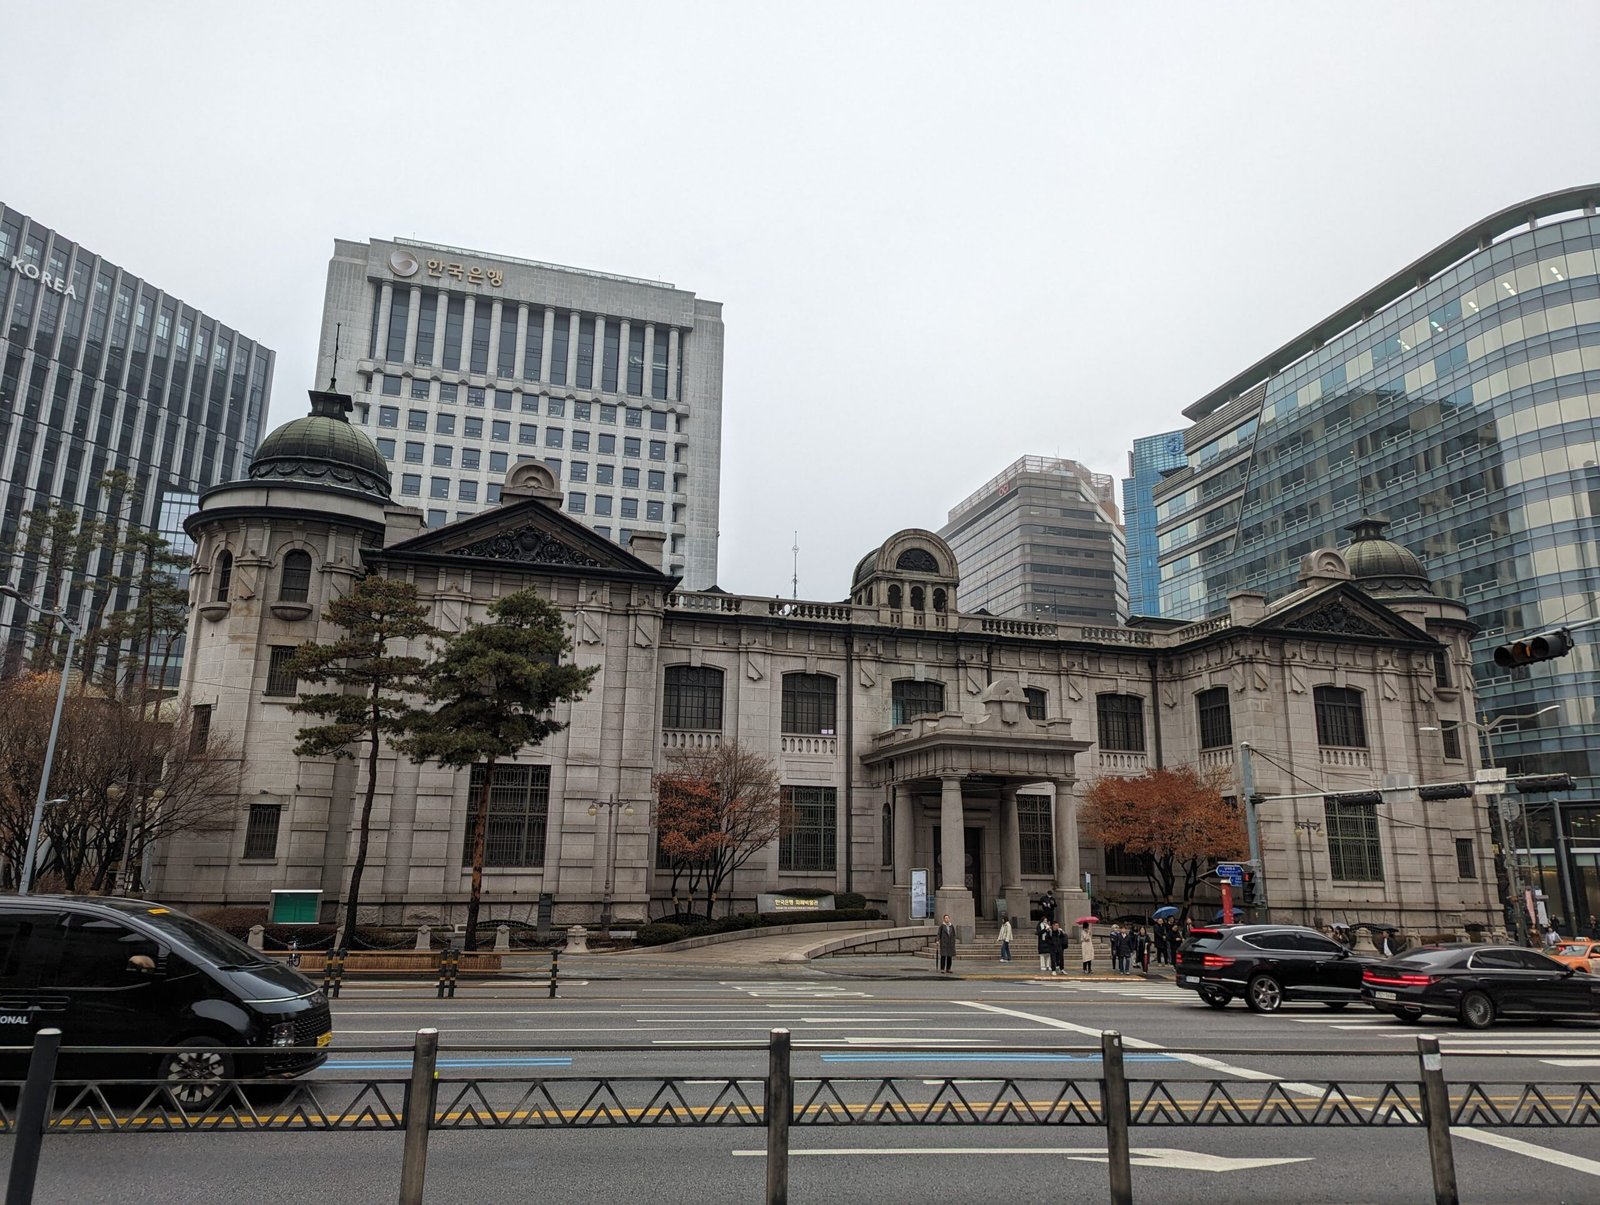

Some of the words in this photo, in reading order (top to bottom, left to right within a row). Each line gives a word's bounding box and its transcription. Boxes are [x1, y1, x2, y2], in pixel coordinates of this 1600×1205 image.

[10, 255, 77, 300] KOREA
[427, 259, 503, 287] 한국은행
[0, 1015, 29, 1024] ONAL
